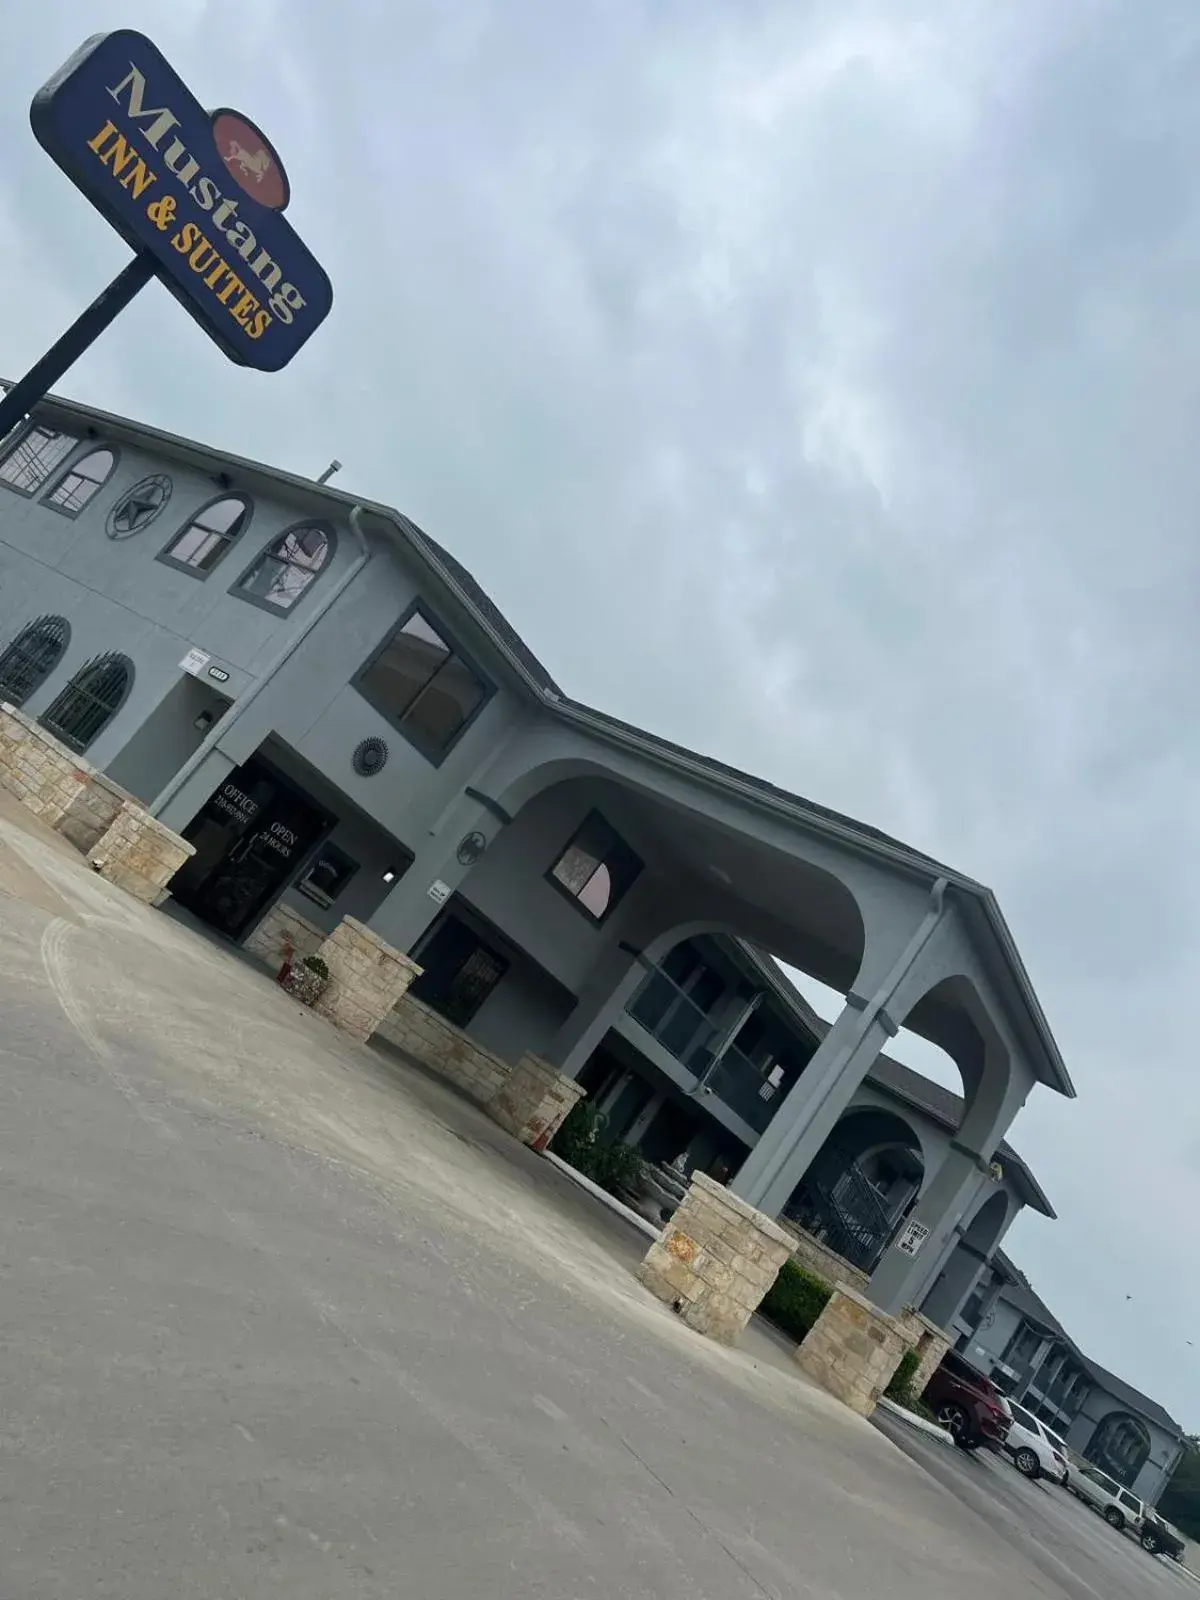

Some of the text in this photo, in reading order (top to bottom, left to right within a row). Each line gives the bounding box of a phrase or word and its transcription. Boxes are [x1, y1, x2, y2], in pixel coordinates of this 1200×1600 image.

[106, 61, 307, 325] Mustang
[87, 119, 273, 340] INN & SUITES
[224, 784, 259, 815] OFFICE
[259, 831, 292, 858] 24 HOURS
[270, 821, 299, 845] OPEN
[907, 1227, 924, 1240] LIMIT
[908, 1236, 914, 1245] 5
[911, 1221, 929, 1235] SPEED
